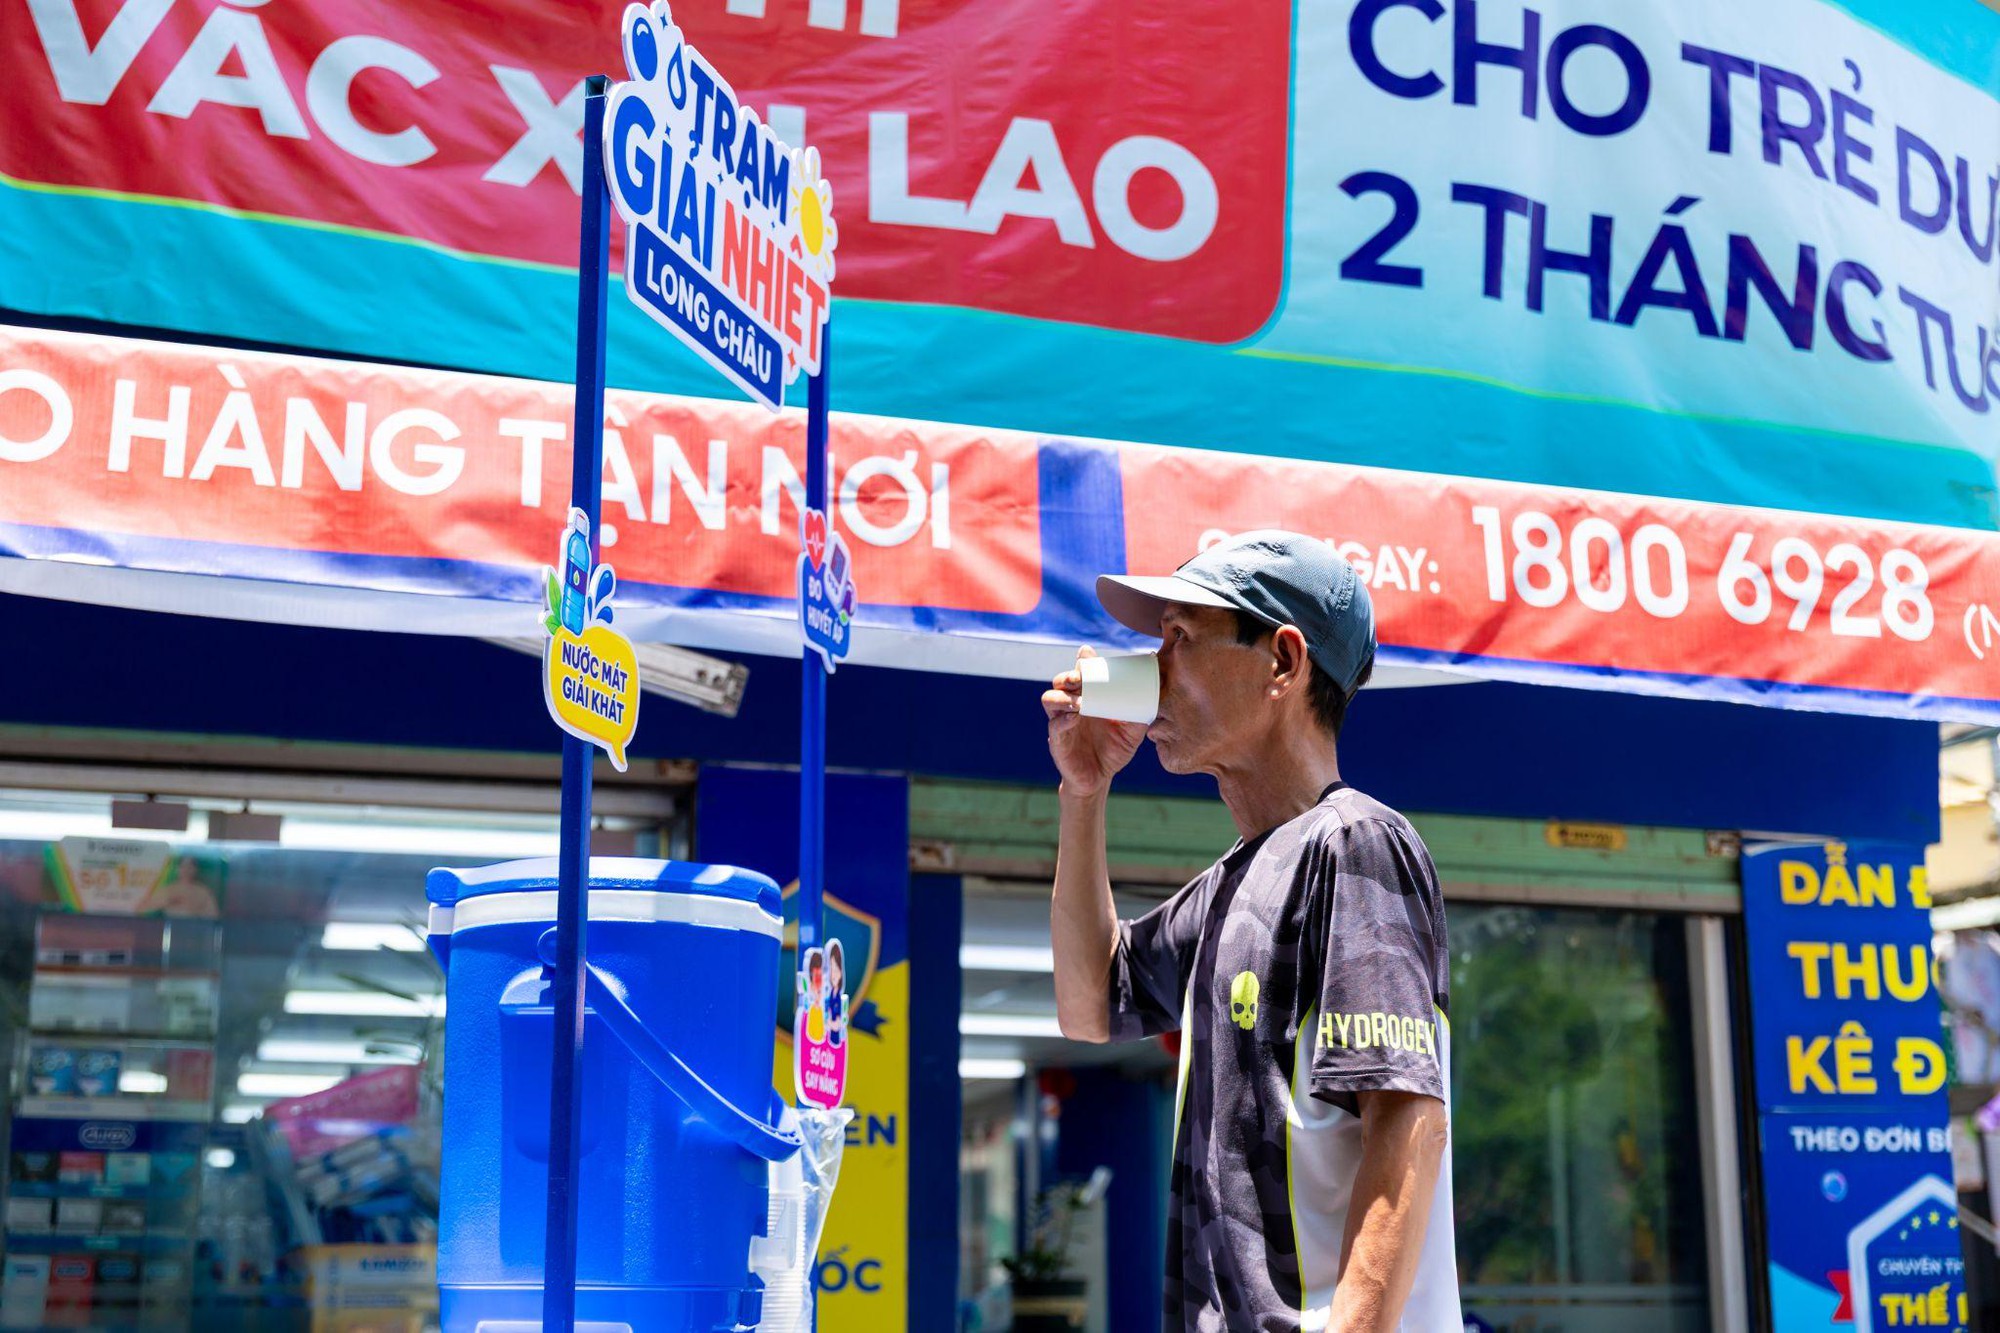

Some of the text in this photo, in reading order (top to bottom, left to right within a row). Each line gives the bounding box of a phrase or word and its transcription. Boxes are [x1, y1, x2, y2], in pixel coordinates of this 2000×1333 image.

[1347, 0, 1651, 137] CHO
[1680, 42, 1880, 207] TRẺ
[690, 59, 790, 227] TRẠM
[868, 110, 1219, 262] LAO
[1337, 170, 1424, 288] 2
[1450, 182, 1894, 362] THÁNG
[647, 247, 773, 384] LONG CHÂU
[106, 363, 466, 496] HÀNG
[500, 402, 728, 548] TẬN
[1325, 537, 1441, 594] GAY:
[1472, 505, 1688, 617] 1800
[1718, 532, 1935, 642] 6928
[562, 640, 628, 693] NƯỚC MÁT
[562, 675, 625, 724] GIẢI KHÁT
[1779, 841, 1896, 908] DẪN
[1787, 942, 1940, 1002] THU
[1317, 1012, 1436, 1056] HYDROGEN
[1786, 1021, 1878, 1094] KÊ
[1790, 1126, 1860, 1152] THEO
[1880, 1282, 1950, 1326] THẾ
